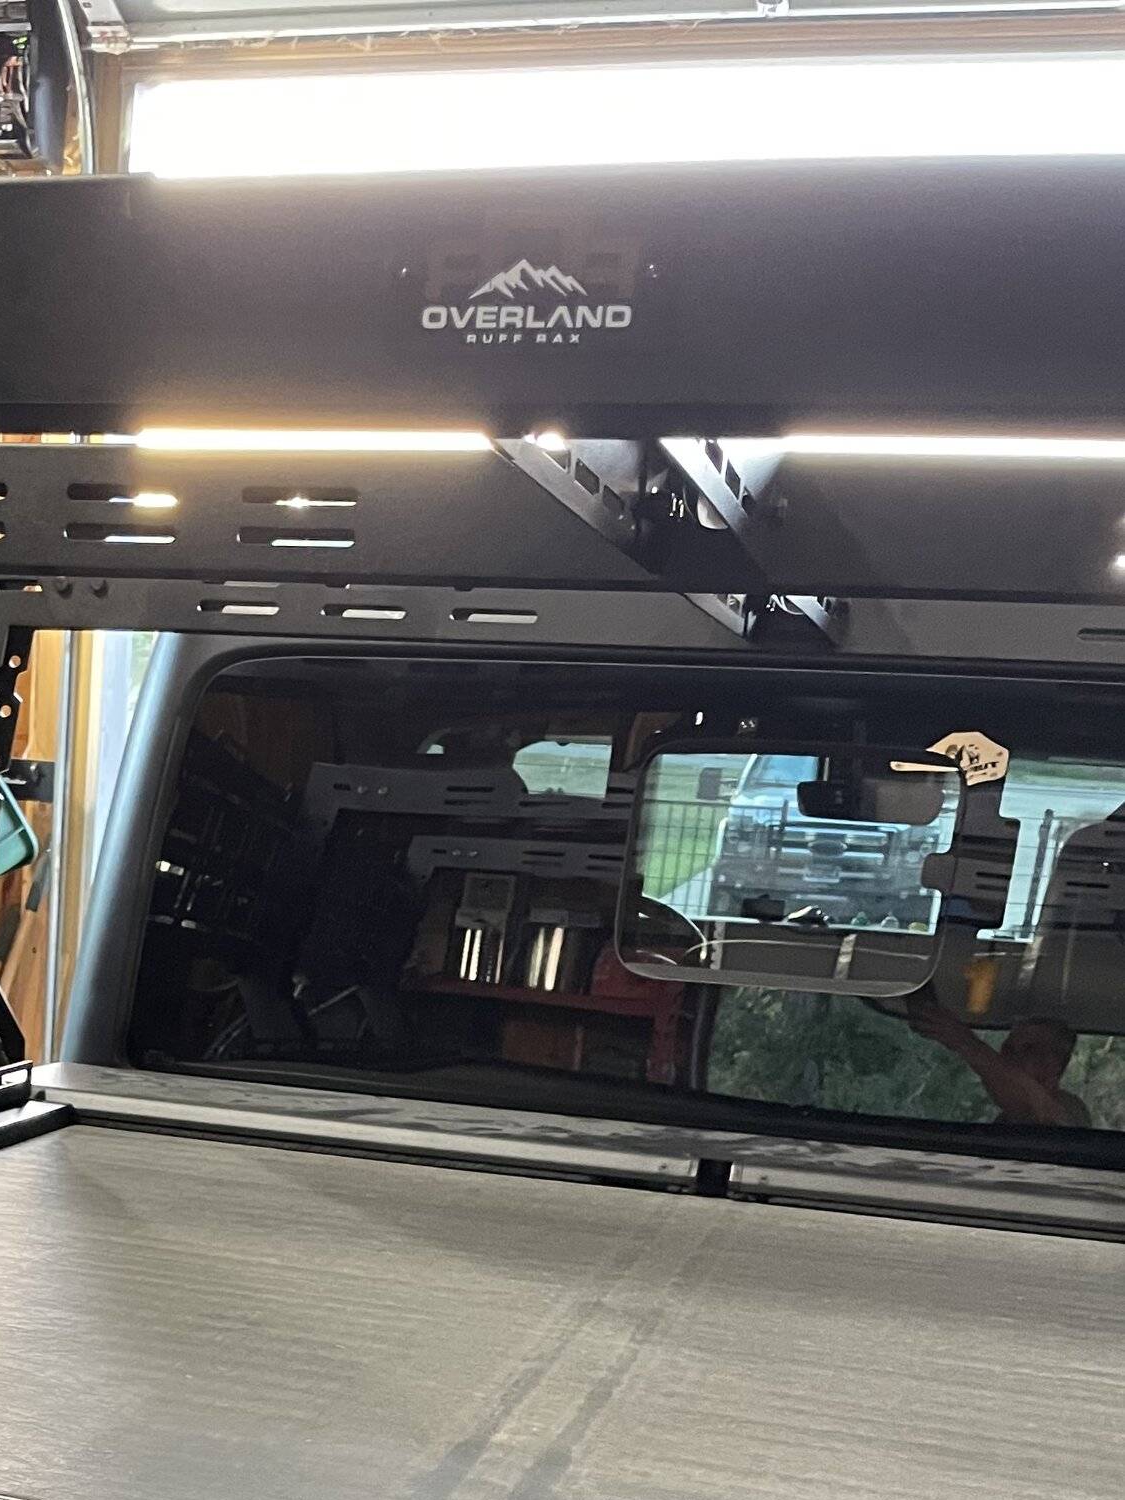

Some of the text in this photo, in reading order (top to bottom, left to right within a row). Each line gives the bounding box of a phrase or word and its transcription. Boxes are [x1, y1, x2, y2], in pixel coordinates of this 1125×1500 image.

[422, 305, 632, 329] OVERLAND
[466, 333, 580, 344] RUFF RAX
